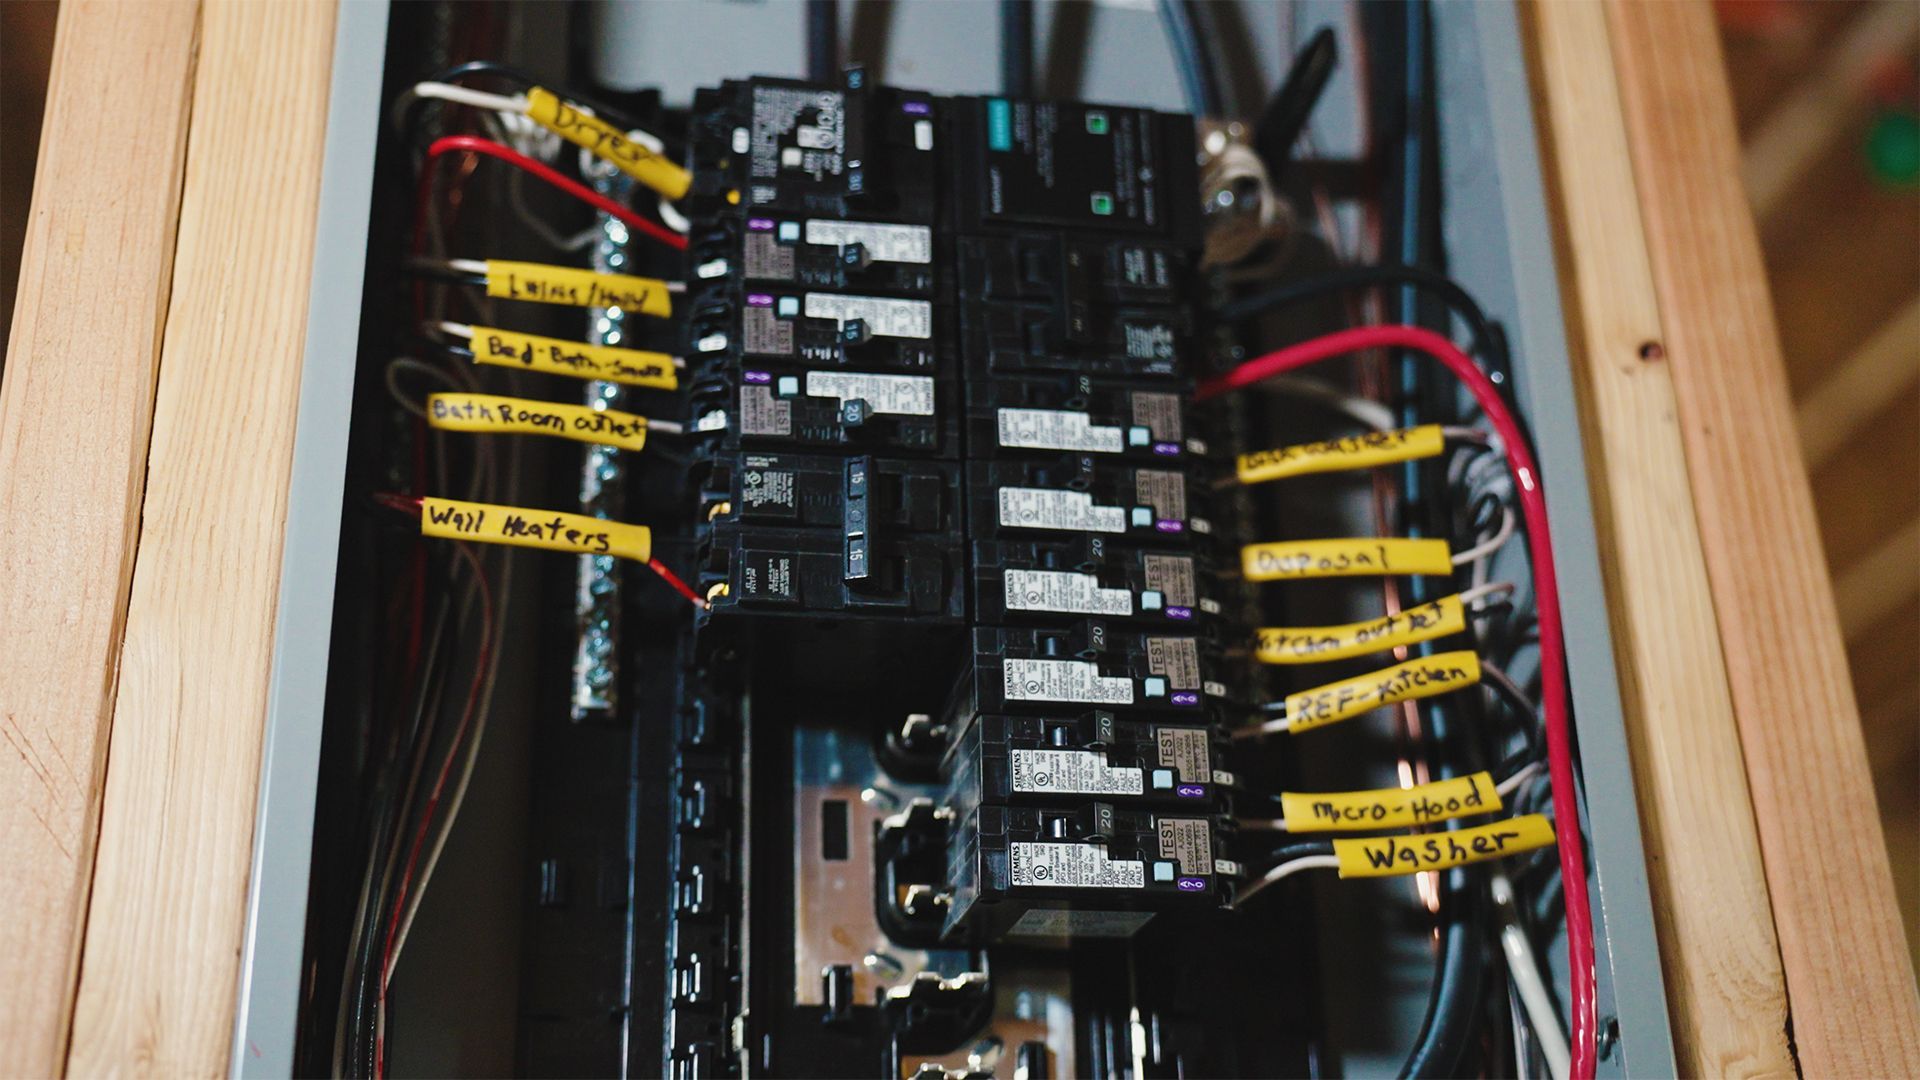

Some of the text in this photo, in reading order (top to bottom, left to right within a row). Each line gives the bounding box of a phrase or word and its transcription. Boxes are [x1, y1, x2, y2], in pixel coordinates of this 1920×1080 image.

[554, 101, 658, 163] Dryer
[846, 324, 858, 339] 15
[1080, 375, 1090, 394] 20
[777, 402, 788, 433] TEST
[846, 405, 859, 422] 20
[1081, 457, 1093, 473] 15
[851, 472, 865, 484] 15
[1138, 473, 1149, 503] TEST
[429, 506, 611, 552] Wall Heaters
[849, 548, 863, 561] 15
[1092, 538, 1103, 557] 20
[1148, 558, 1159, 588] TEST
[1093, 626, 1104, 645] 20
[1150, 640, 1163, 672] TEST
[1101, 717, 1112, 737] 20
[1161, 731, 1173, 764] TEST
[1101, 808, 1112, 828] 20
[1161, 821, 1174, 856] TEST
[1364, 830, 1520, 870] Washer
